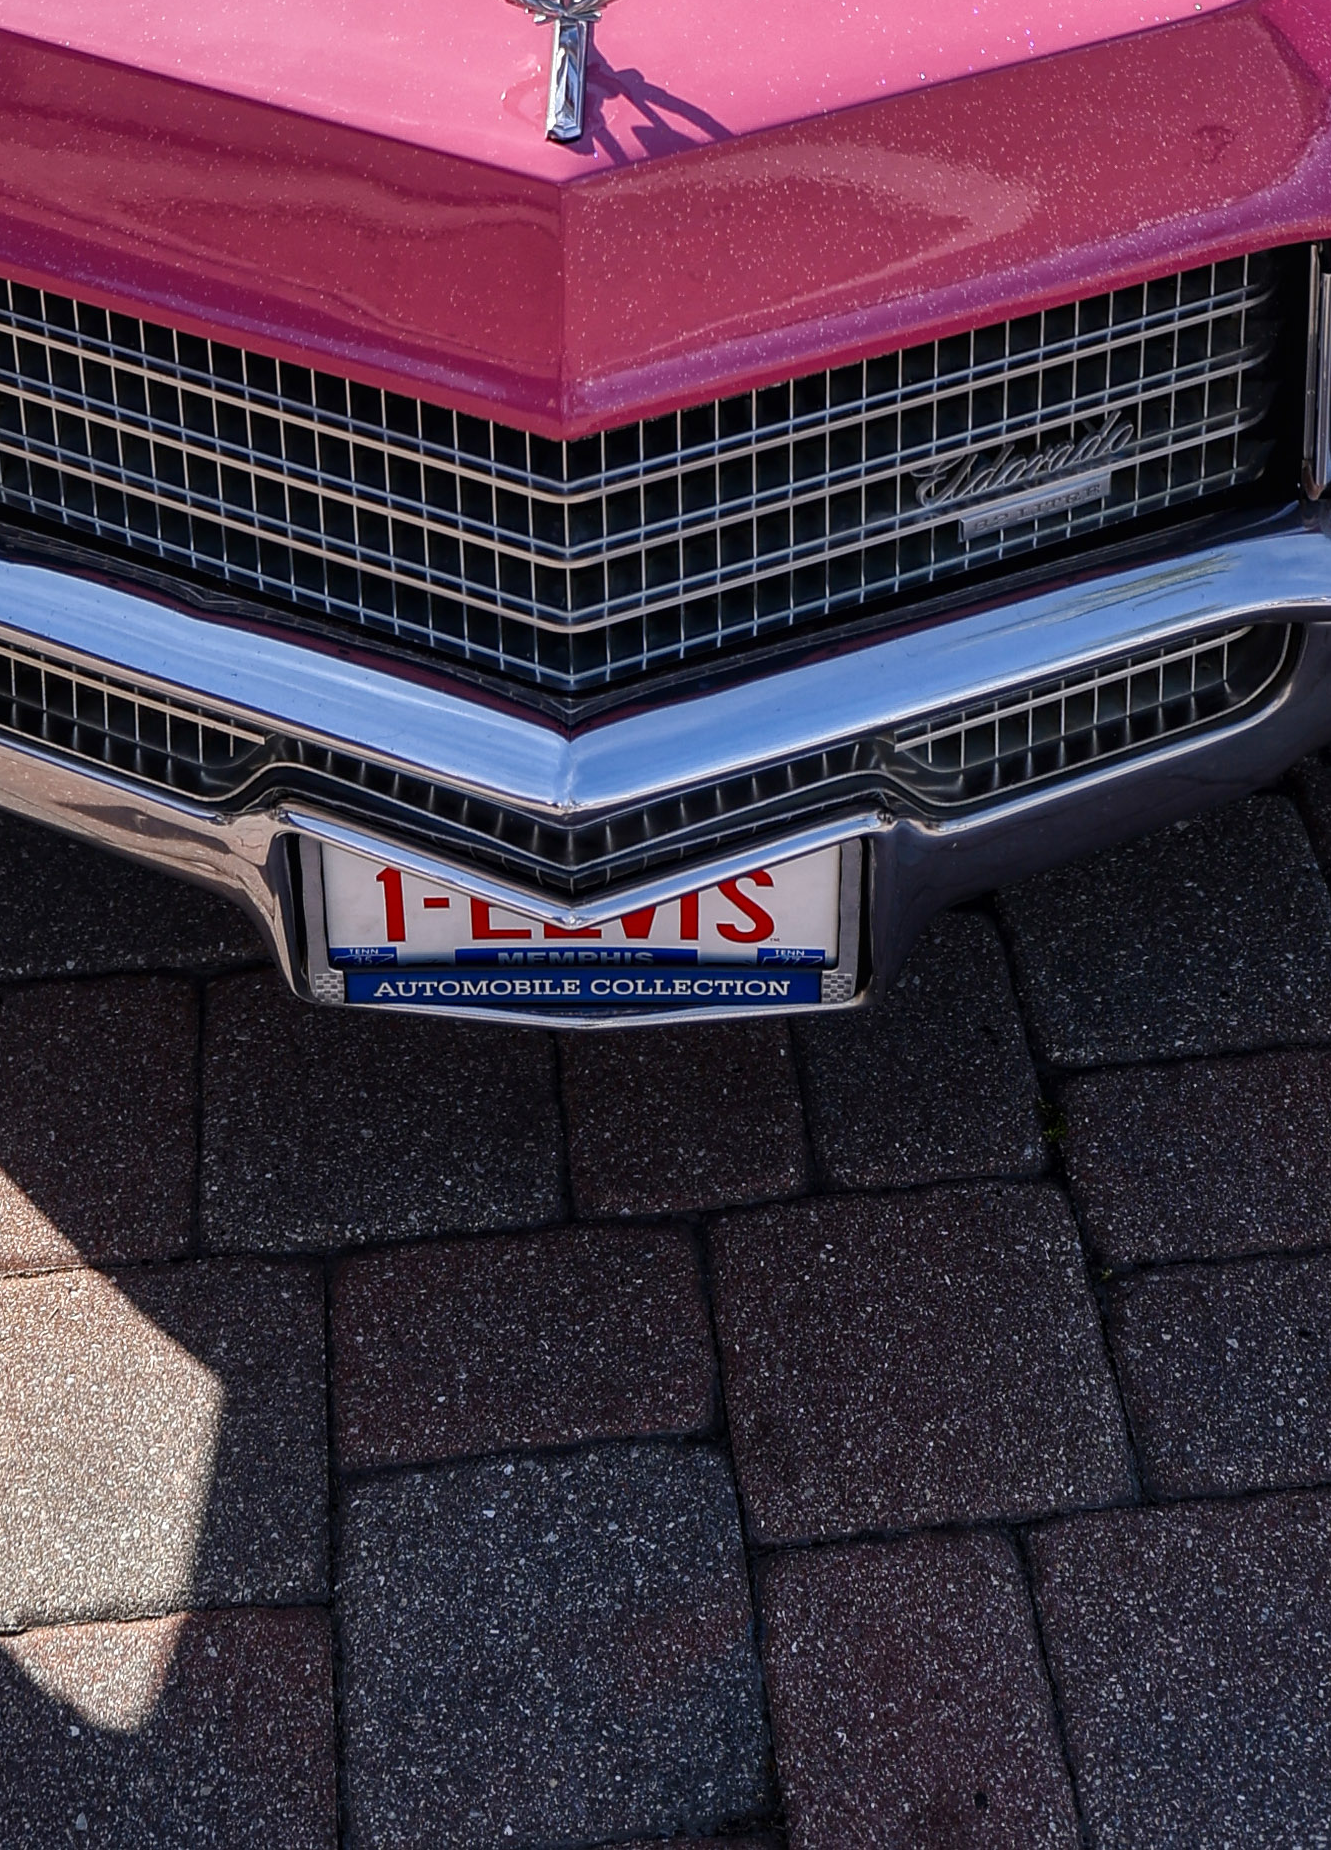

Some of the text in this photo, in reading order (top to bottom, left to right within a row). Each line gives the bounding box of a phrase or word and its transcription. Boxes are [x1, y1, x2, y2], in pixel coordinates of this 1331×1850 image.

[910, 410, 1134, 507] Eldorado
[376, 867, 774, 943] 1-IS
[497, 951, 654, 966] MEMPHIS
[373, 979, 790, 997] AUTOMOBILE COLLECTION
